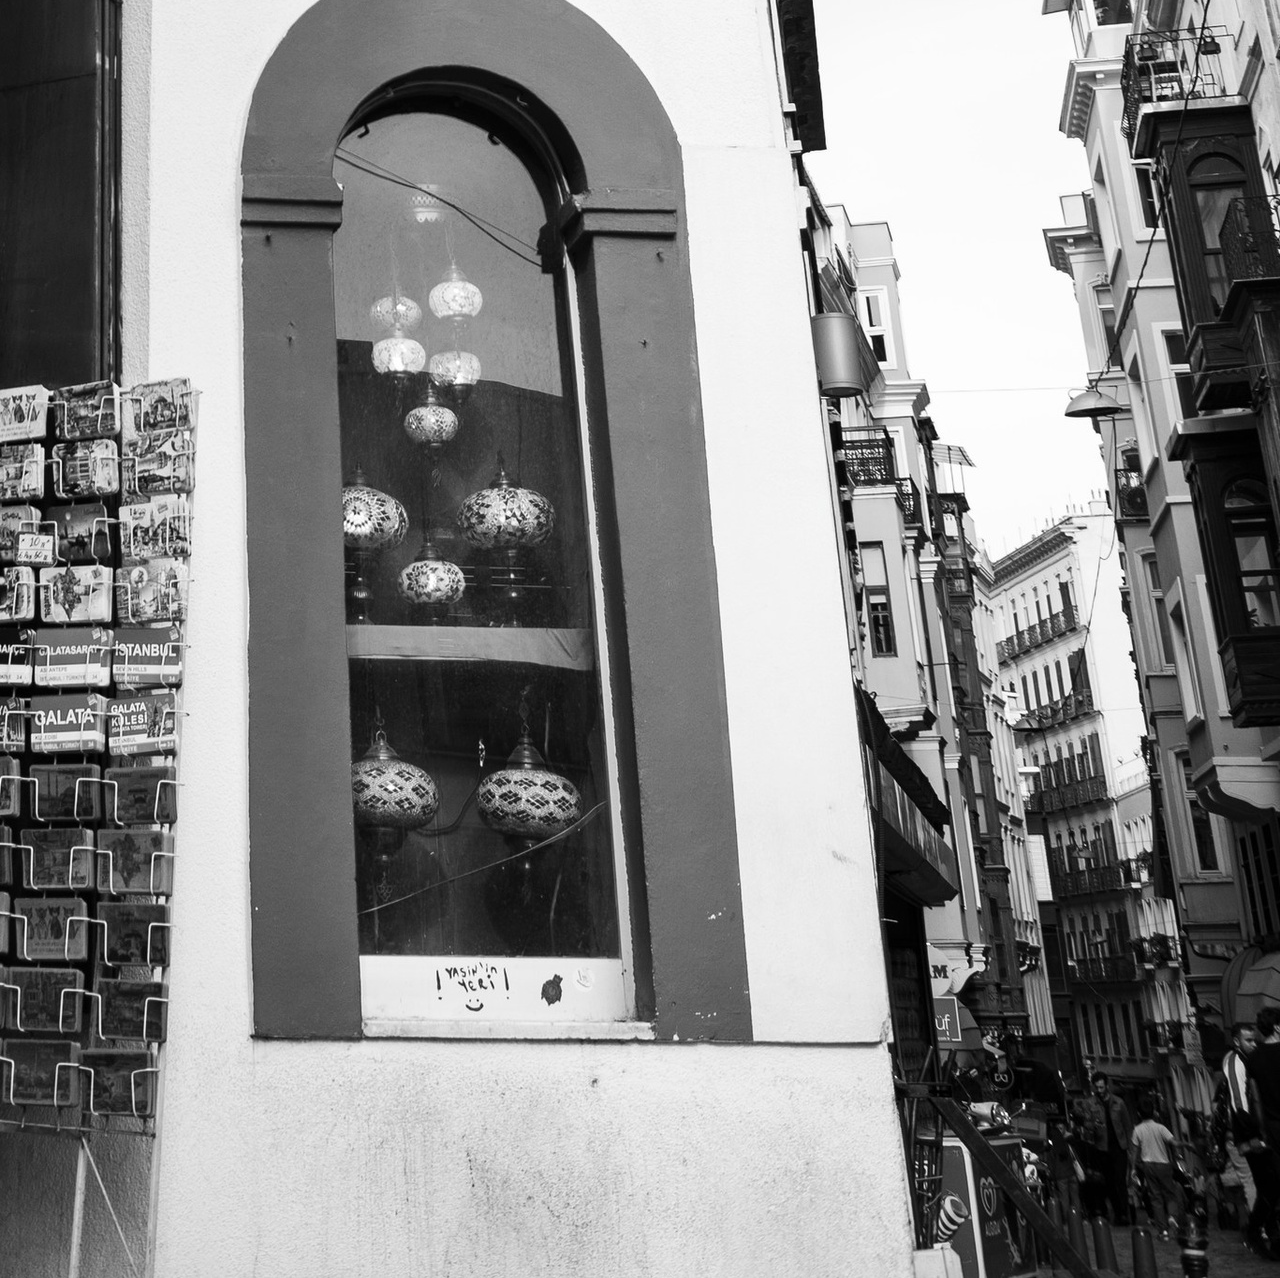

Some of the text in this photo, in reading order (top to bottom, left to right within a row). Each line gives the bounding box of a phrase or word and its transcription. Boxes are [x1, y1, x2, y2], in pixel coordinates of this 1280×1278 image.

[38, 644, 99, 656] GALATASARAY
[115, 640, 177, 656] İSTANBUL
[111, 702, 147, 714] GALATA
[34, 708, 95, 726] GALATA
